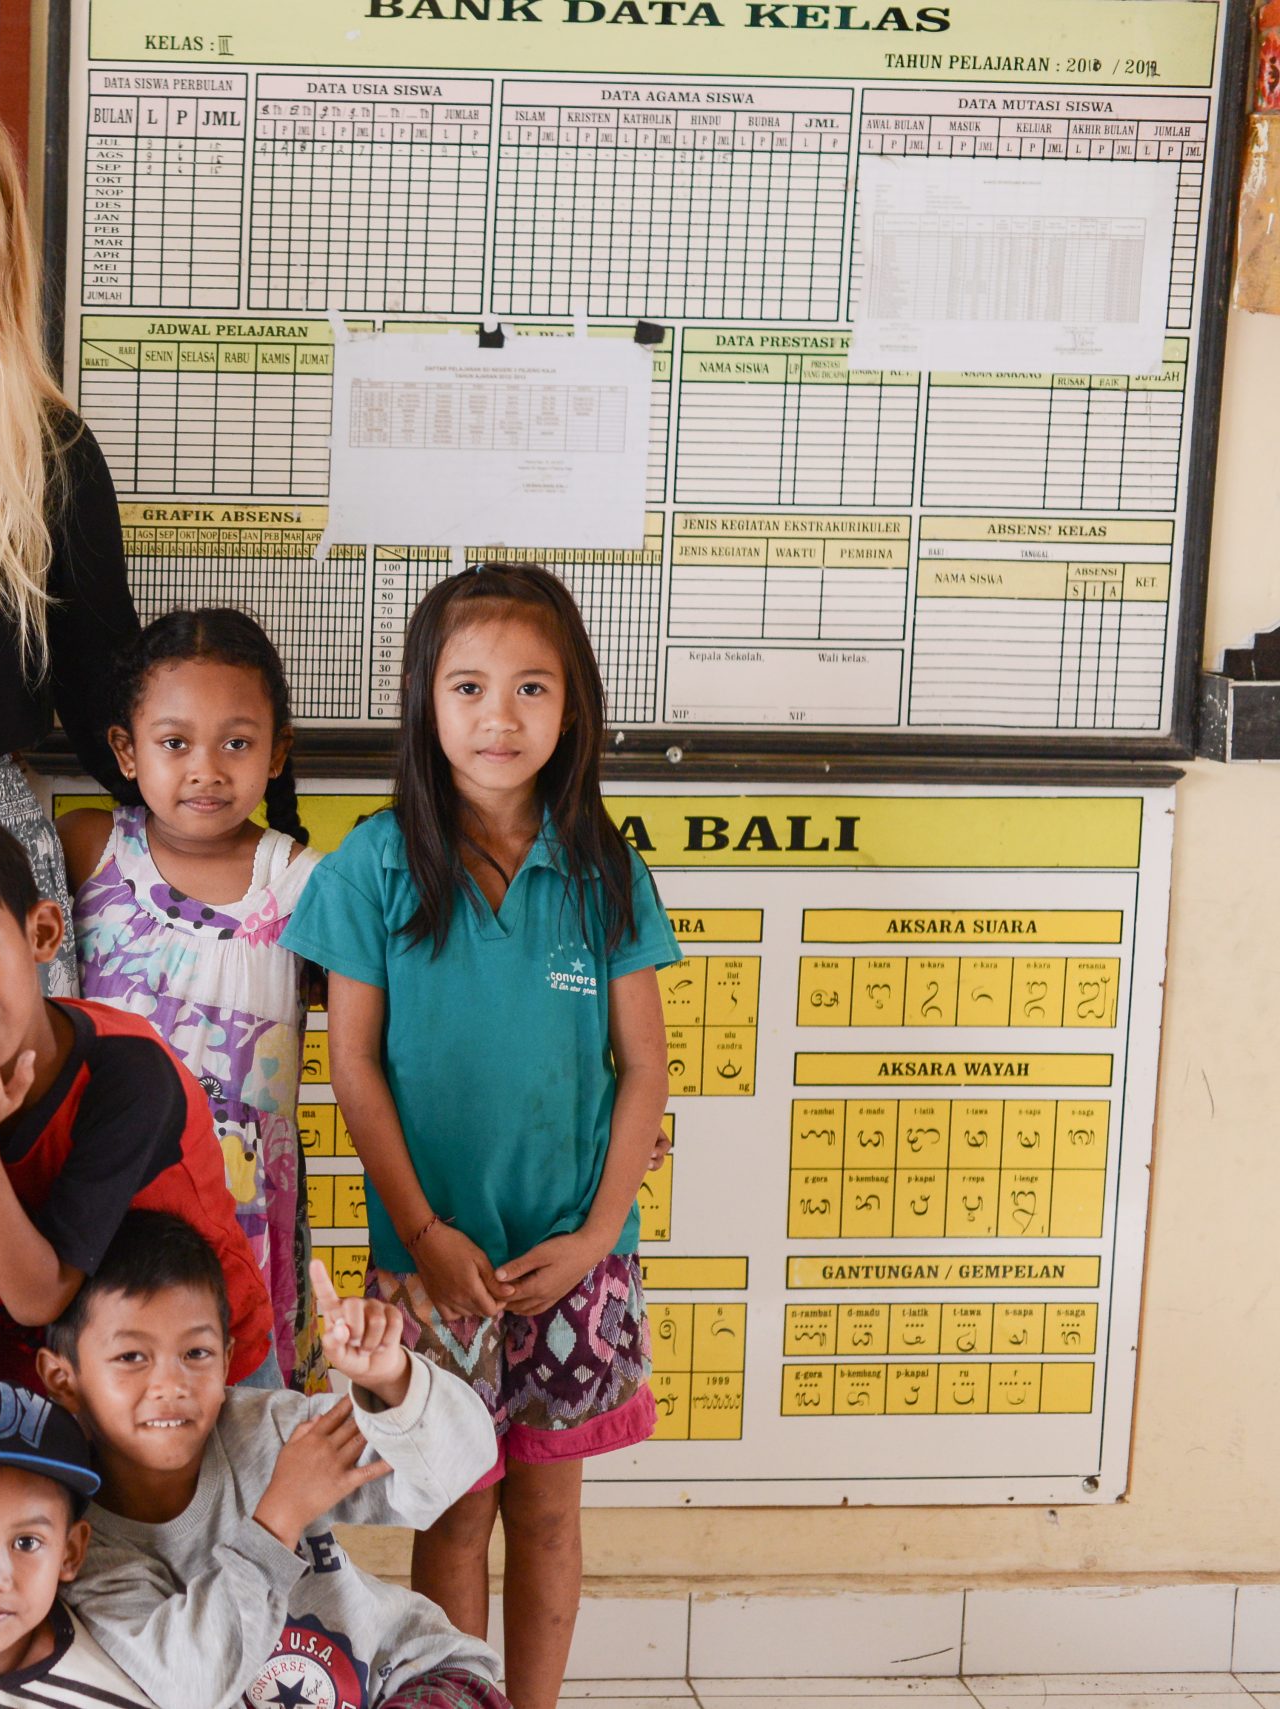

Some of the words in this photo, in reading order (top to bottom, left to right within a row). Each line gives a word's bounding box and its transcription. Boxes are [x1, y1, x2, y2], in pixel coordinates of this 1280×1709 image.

[364, 0, 543, 23] BANK
[562, 0, 724, 27] DATA
[744, 3, 951, 33] KELAS
[144, 35, 204, 52] KELAS
[885, 53, 942, 70] TAHUN
[949, 55, 1050, 72] PELAJARAN
[104, 77, 131, 89] DATA
[134, 78, 169, 90] SISWA
[173, 80, 233, 91] PERBULAN
[307, 82, 347, 94] DATA
[352, 84, 388, 95] USIA
[394, 85, 443, 97] SISWA
[601, 89, 641, 101] DATA
[646, 90, 701, 103] AGAMA
[706, 92, 754, 104] SISWA
[958, 98, 997, 110] DATA
[1002, 99, 1060, 112] MUTASI
[1066, 101, 1114, 113] SISWA
[93, 108, 133, 124] BULAN
[202, 111, 241, 126] JML
[444, 109, 479, 120] JUMLAH
[515, 111, 546, 122] ISLAM
[567, 112, 611, 124] KRISTEN
[622, 113, 672, 125] KATHOLIK
[690, 115, 721, 126] HINDU
[748, 116, 780, 128] BUDHA
[804, 118, 839, 128] JML
[866, 119, 891, 131] AWAL
[894, 120, 925, 132] BULAN
[949, 121, 981, 133] MASUK
[1016, 122, 1052, 135] KELUAR
[1072, 123, 1101, 135] AKHIR
[1104, 124, 1135, 136] BULAN
[1153, 126, 1192, 137] JUMLAH
[96, 151, 124, 159] AGS
[96, 176, 123, 184] OKT
[95, 201, 122, 209] DES
[93, 251, 119, 259] APR
[93, 263, 117, 271] MEI
[92, 276, 118, 284] JUN
[86, 291, 122, 300] JUMLAH
[147, 323, 211, 336] JADWAL
[217, 325, 308, 338] PELAJARAN
[715, 334, 754, 347] DATA
[759, 336, 835, 348] PRESTASI
[84, 358, 110, 367] WAKTU
[145, 351, 174, 362] SENIN
[180, 351, 215, 363] SELASA
[224, 352, 250, 363] RABU
[261, 353, 291, 365] KAMIS
[299, 354, 329, 365] JUMAT
[699, 362, 731, 373] NAMA
[735, 362, 769, 374] SISWA
[143, 509, 215, 522] GRAFIK
[220, 511, 302, 523] ABSENSI
[683, 519, 717, 530] JENIS
[721, 520, 780, 531] KEGIATAN
[784, 521, 901, 533] EKSTRAKURIKULER
[987, 524, 1052, 536] ABSENSI
[1058, 526, 1107, 537] KELAS
[679, 546, 708, 556] JENIS
[711, 547, 761, 557] KEGIATAN
[775, 548, 816, 558] WAKTU
[840, 549, 893, 559] PEMBINA
[1075, 567, 1118, 577] ABSENSI
[382, 578, 394, 586] 90
[934, 572, 966, 584] NAMA
[970, 573, 1004, 585] SISWA
[381, 592, 394, 600] 80
[381, 607, 393, 615] 70
[379, 650, 392, 658] 40
[689, 651, 722, 662] Kepala
[818, 653, 839, 663] Wali
[683, 816, 860, 851] BALI
[887, 919, 966, 934] AKSARA
[973, 920, 1038, 934] SUARA
[550, 971, 597, 987] convers
[878, 1062, 957, 1077] AKSARA
[964, 1063, 1030, 1077] WAYAH
[351, 1253, 368, 1263] nya
[822, 1265, 939, 1280] GANTUNGAN
[958, 1264, 1066, 1279] GEMPELAN
[847, 1308, 880, 1317] d-madu
[706, 1376, 730, 1385] 1999
[795, 1371, 822, 1380] g-gora
[290, 1632, 333, 1667] U.S.A.
[252, 1661, 306, 1701] CONVERSE
